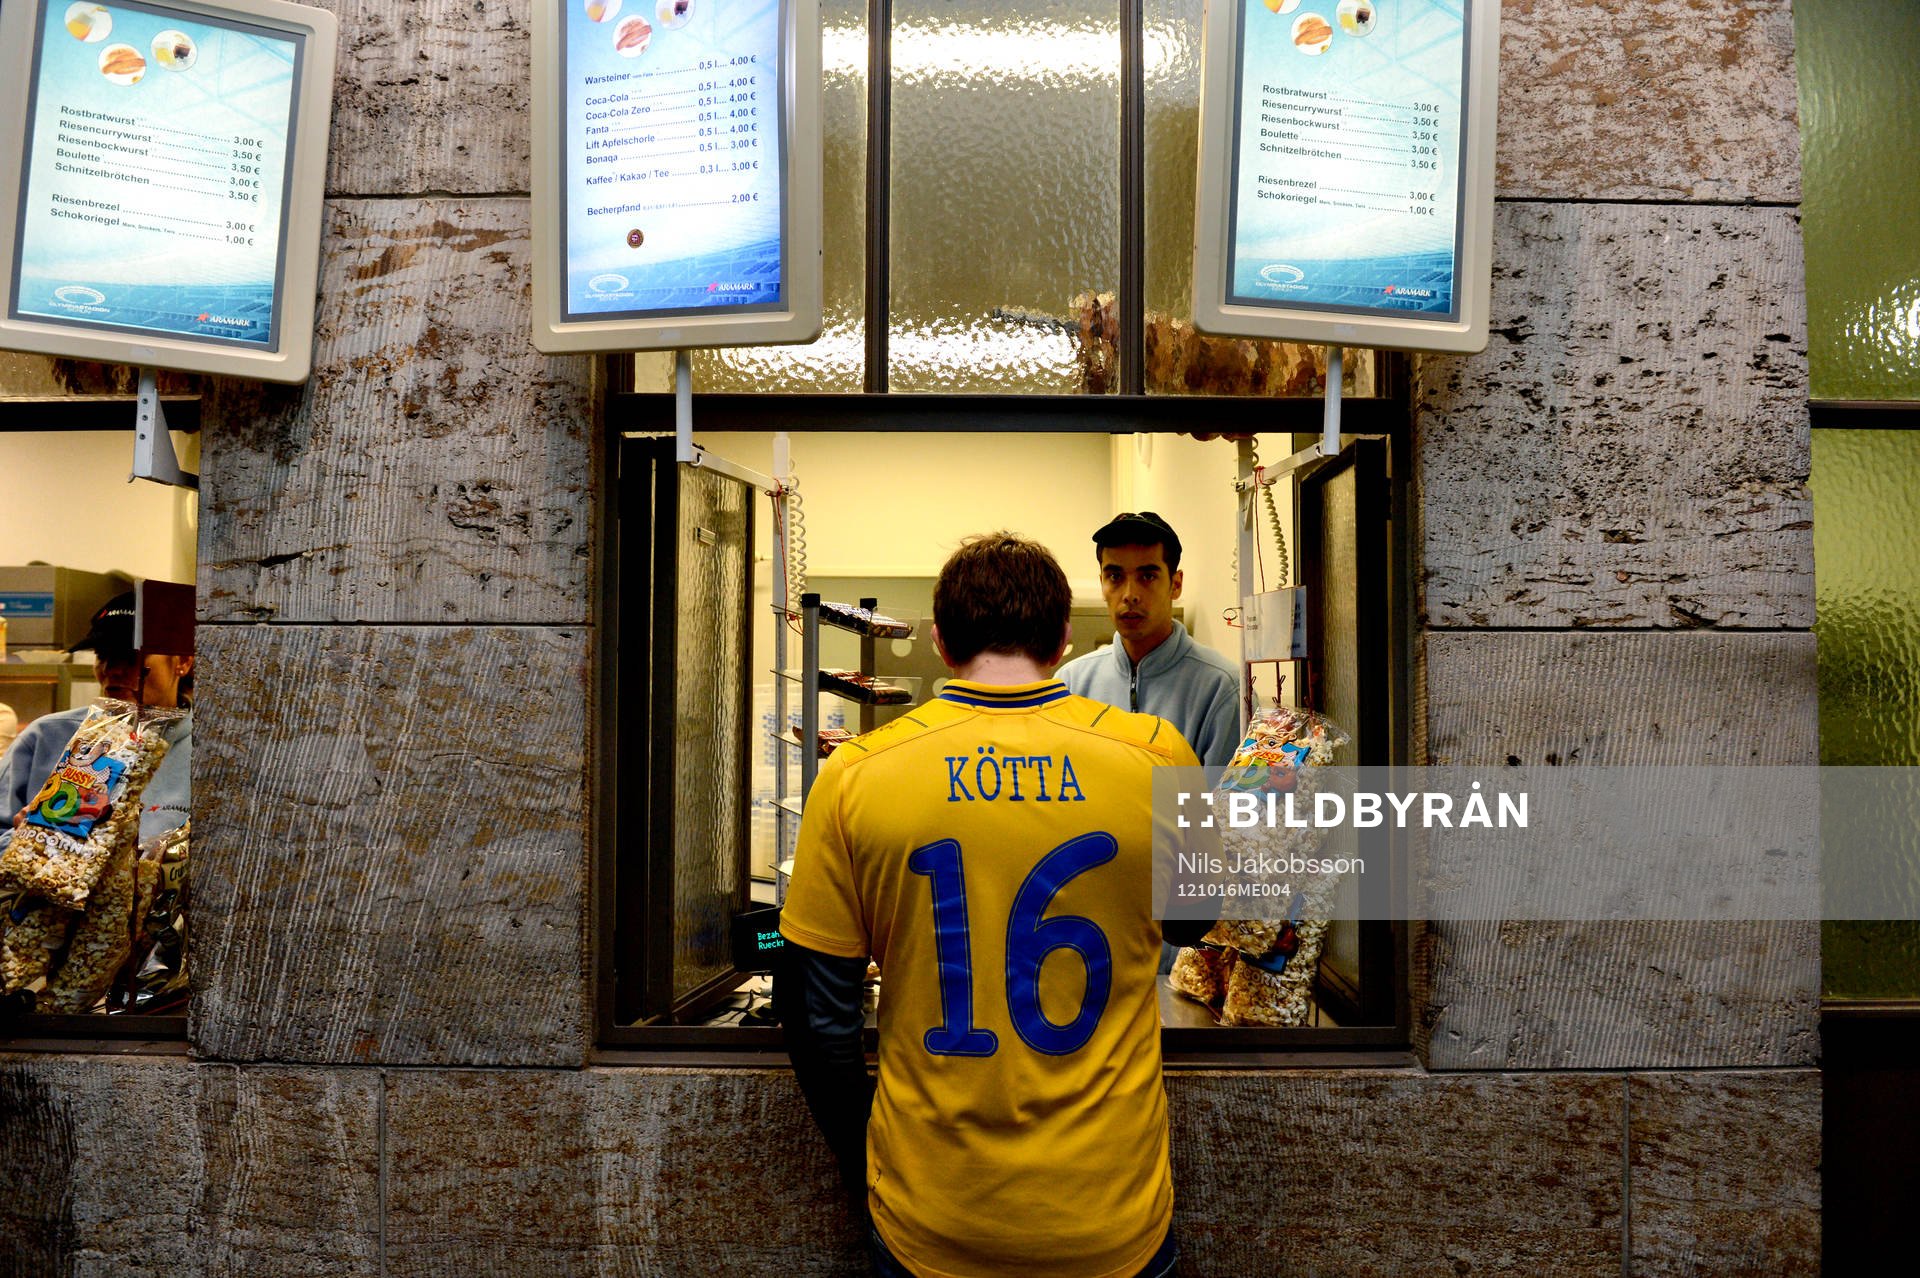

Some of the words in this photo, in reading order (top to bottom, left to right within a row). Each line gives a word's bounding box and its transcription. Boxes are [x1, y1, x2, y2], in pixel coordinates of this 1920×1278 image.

[585, 73, 631, 84] Warsteiner
[700, 61, 712, 70] 0,5
[730, 56, 748, 66] 4,00
[751, 55, 756, 63] €
[585, 94, 629, 105] Coca-Cola
[699, 82, 711, 91] 0,5
[729, 78, 747, 87] 4,00
[1262, 85, 1327, 99] Rostbratwurst
[1414, 103, 1431, 111] 3,00
[586, 108, 628, 120] Coca-Cola
[631, 106, 650, 115] Zero
[699, 97, 711, 106] 0,5
[730, 93, 748, 103] 4,00
[751, 92, 756, 100] €
[1262, 99, 1342, 116] Riesencurrywurst
[1413, 117, 1430, 126] 3,50
[60, 106, 135, 126] Rostbratwurst
[234, 136, 254, 146] 3,00
[586, 126, 609, 135] Fanta
[699, 113, 711, 121] 0,5
[730, 109, 748, 118] 4,00
[751, 108, 756, 116] €
[1261, 114, 1340, 130] Riesenbockwurst
[1413, 131, 1430, 140] 3,50
[60, 120, 152, 142] Riesencurrywurst
[233, 150, 252, 159] 3,50
[586, 141, 600, 149] Lift
[602, 135, 655, 149] Apfelschorle
[699, 128, 712, 136] 0,5
[730, 124, 748, 134] 4,00
[752, 123, 757, 131] €
[1260, 128, 1298, 140] Boulette
[1412, 146, 1429, 154] 3,00
[58, 134, 148, 156] Riesenbockwurst
[232, 164, 251, 173] 3,50
[586, 155, 618, 164] Bonaqa
[700, 143, 712, 152] 0,5
[731, 139, 749, 149] 3,00
[1260, 143, 1342, 159] Schnitzelbrötchen
[1411, 160, 1429, 169] 3,50
[56, 148, 100, 162] Boulette
[230, 177, 250, 187] 3,00
[586, 176, 612, 185] Kaffee
[620, 172, 646, 181] Kakao
[654, 169, 669, 178] Tee
[700, 165, 713, 174] 0,3
[732, 162, 750, 172] 3,00
[55, 162, 150, 184] Schnitzelbrötchen
[229, 191, 249, 200] 3,50
[1258, 175, 1317, 189] Riesenbrezel
[1410, 192, 1427, 200] 3,00
[52, 194, 120, 211] Riesenbrezel
[226, 221, 246, 230] 3,00
[587, 203, 640, 216] Becherpfand
[732, 194, 750, 203] 2,00
[1257, 190, 1317, 204] Schokoriegel
[1409, 206, 1426, 215] 1,00
[50, 208, 120, 226] Schokoriegel
[225, 235, 245, 244] 1,00
[719, 282, 754, 291] ARAMARK
[1394, 288, 1430, 297] ARAMARK
[210, 315, 250, 326] ARAMARK
[62, 767, 95, 787] BUSSY
[944, 746, 1086, 802] KÖTTA
[908, 831, 1118, 1057] 16
